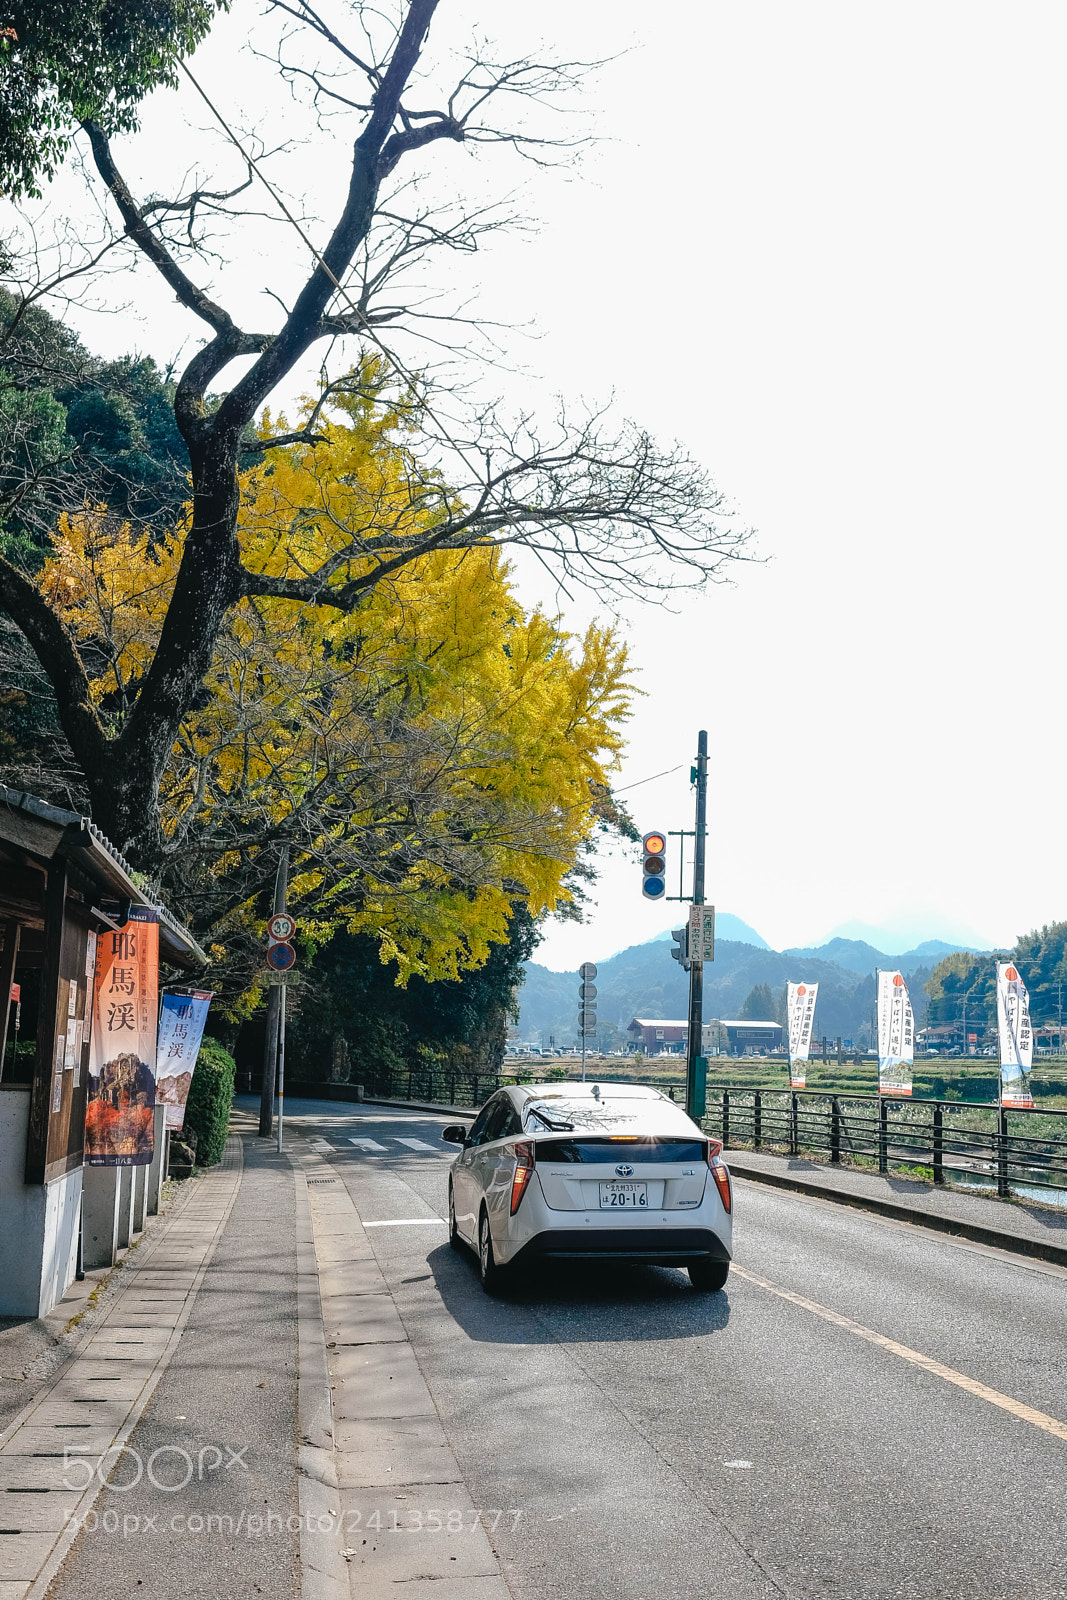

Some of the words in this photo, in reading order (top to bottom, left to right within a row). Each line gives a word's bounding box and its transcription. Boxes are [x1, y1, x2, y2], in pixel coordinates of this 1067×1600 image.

[107, 931, 136, 1032] 耶馬渓
[167, 1003, 193, 1059] 耶馬渓
[610, 1192, 646, 1206] 20-16
